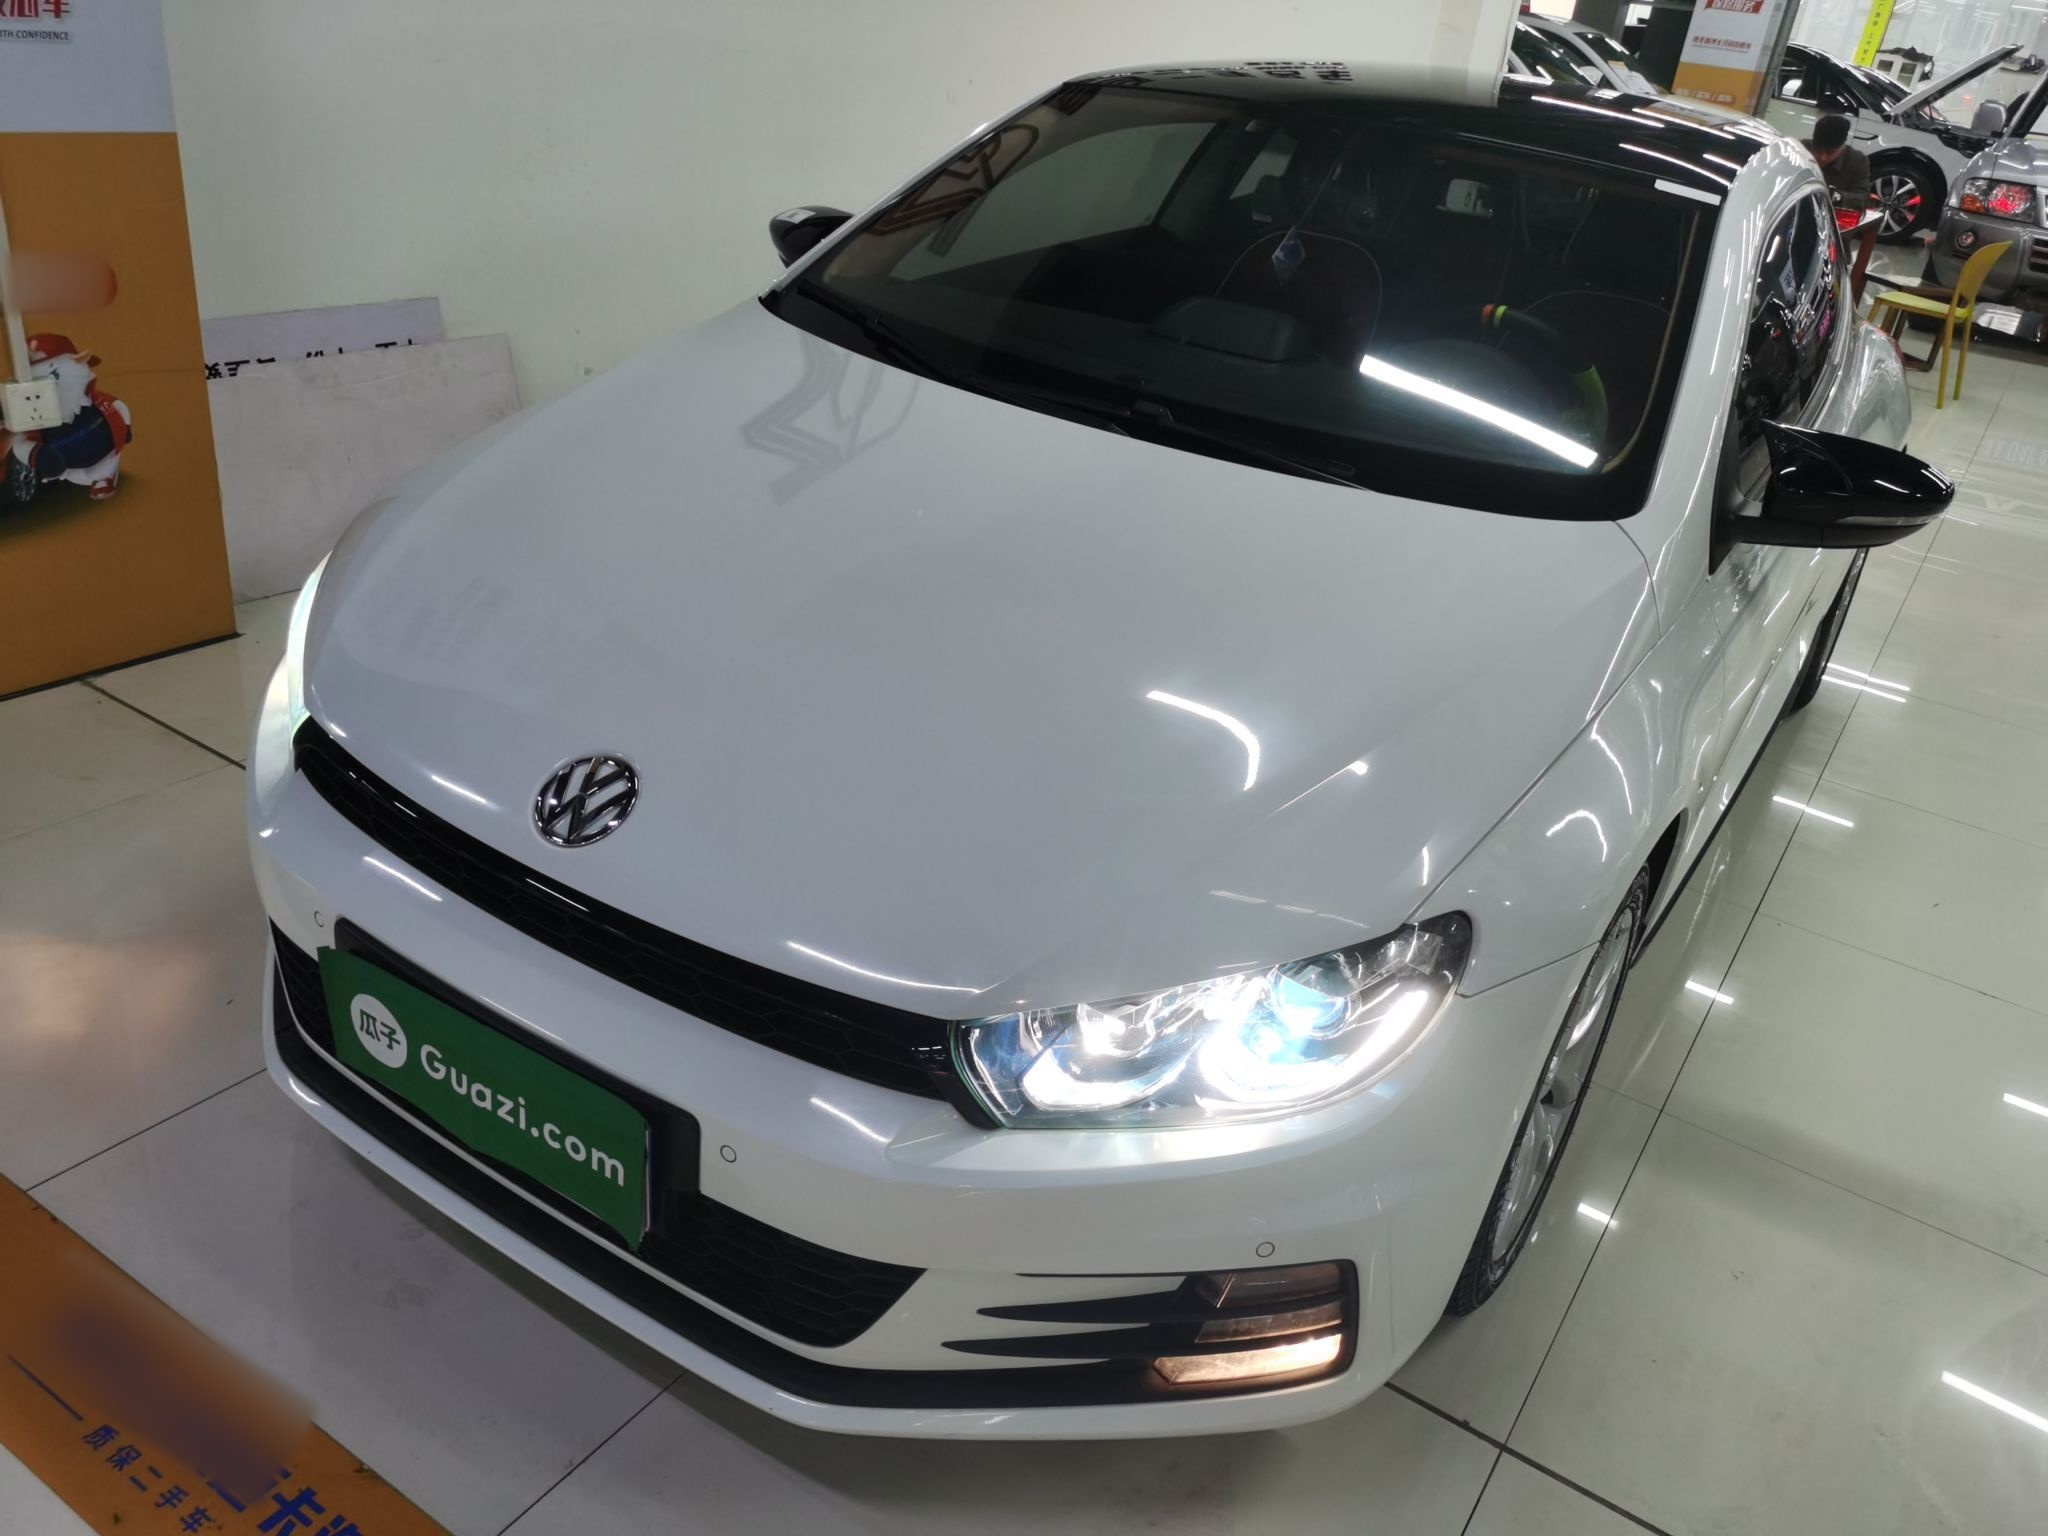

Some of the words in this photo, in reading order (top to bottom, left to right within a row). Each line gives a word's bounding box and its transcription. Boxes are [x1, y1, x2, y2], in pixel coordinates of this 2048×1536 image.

[16, 30, 69, 40] CONFIDENCE
[359, 1008, 401, 1050] 瓜子
[420, 1044, 624, 1187] Guazi.com
[82, 1424, 213, 1533] 质保二手车
